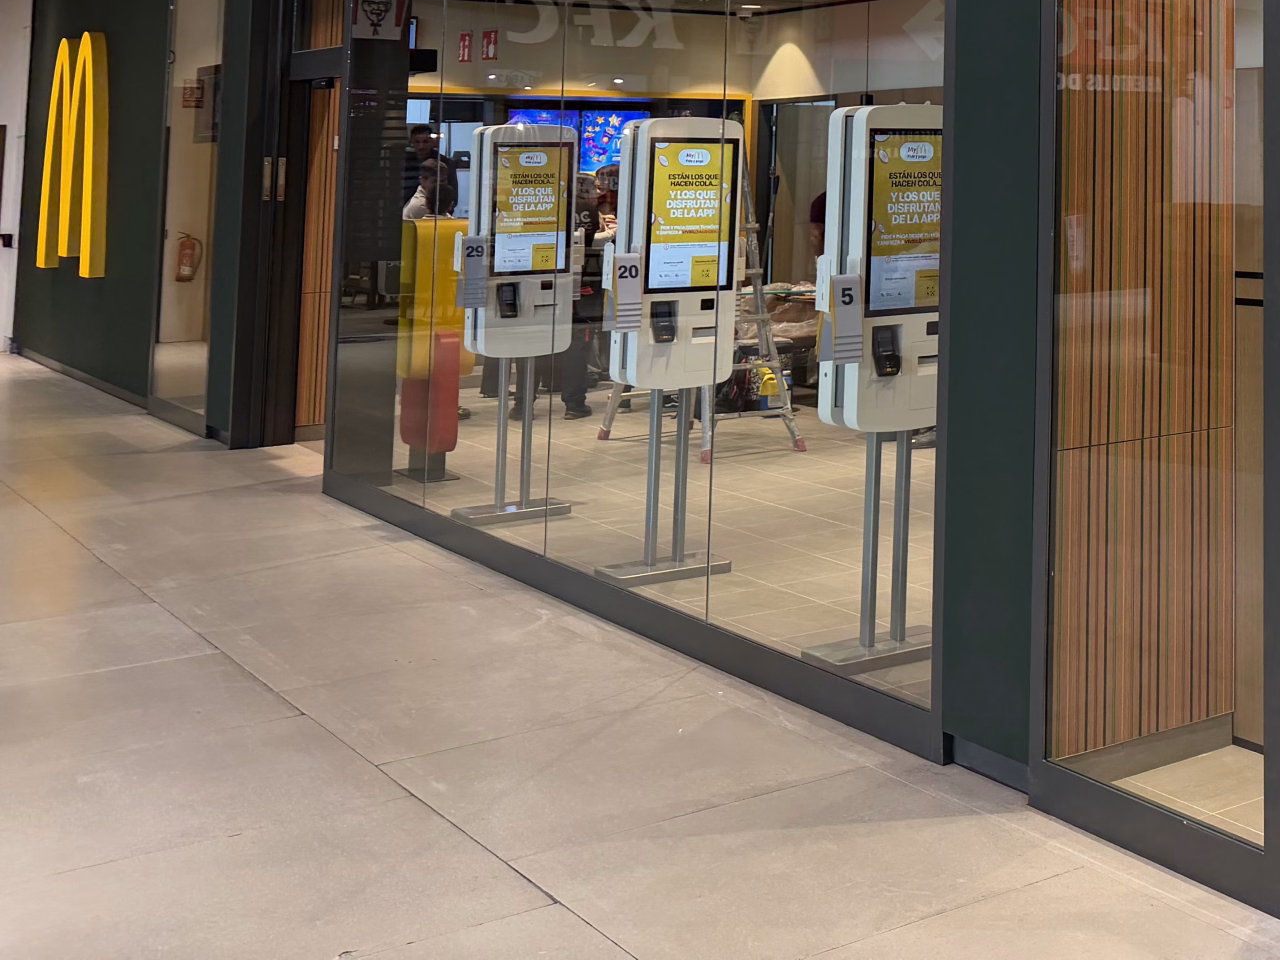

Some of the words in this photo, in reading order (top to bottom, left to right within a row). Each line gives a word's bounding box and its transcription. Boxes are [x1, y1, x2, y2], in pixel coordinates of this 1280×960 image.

[668, 172, 690, 180] ESTÁN
[888, 170, 912, 179] ESTÁN
[535, 187, 553, 195] QUE
[669, 191, 677, 199] Y
[677, 190, 695, 199] LOS
[696, 190, 717, 199] QUE
[509, 195, 555, 203] DISFRUTAN
[890, 192, 898, 201] Y
[899, 192, 918, 201] LOS
[919, 191, 940, 202] QUE
[512, 203, 524, 211] DE
[525, 203, 536, 211] LA
[536, 203, 553, 211] APP
[666, 199, 718, 208] DISFRUTAN
[888, 202, 941, 213] DISFRUTAN
[670, 210, 683, 218] DE
[684, 210, 697, 218] LA
[697, 209, 716, 217] APP
[891, 215, 906, 224] DE
[907, 214, 919, 224] LA
[920, 214, 940, 223] APP
[465, 245, 485, 258] 29
[618, 264, 639, 279] 20
[841, 287, 854, 305] 5
